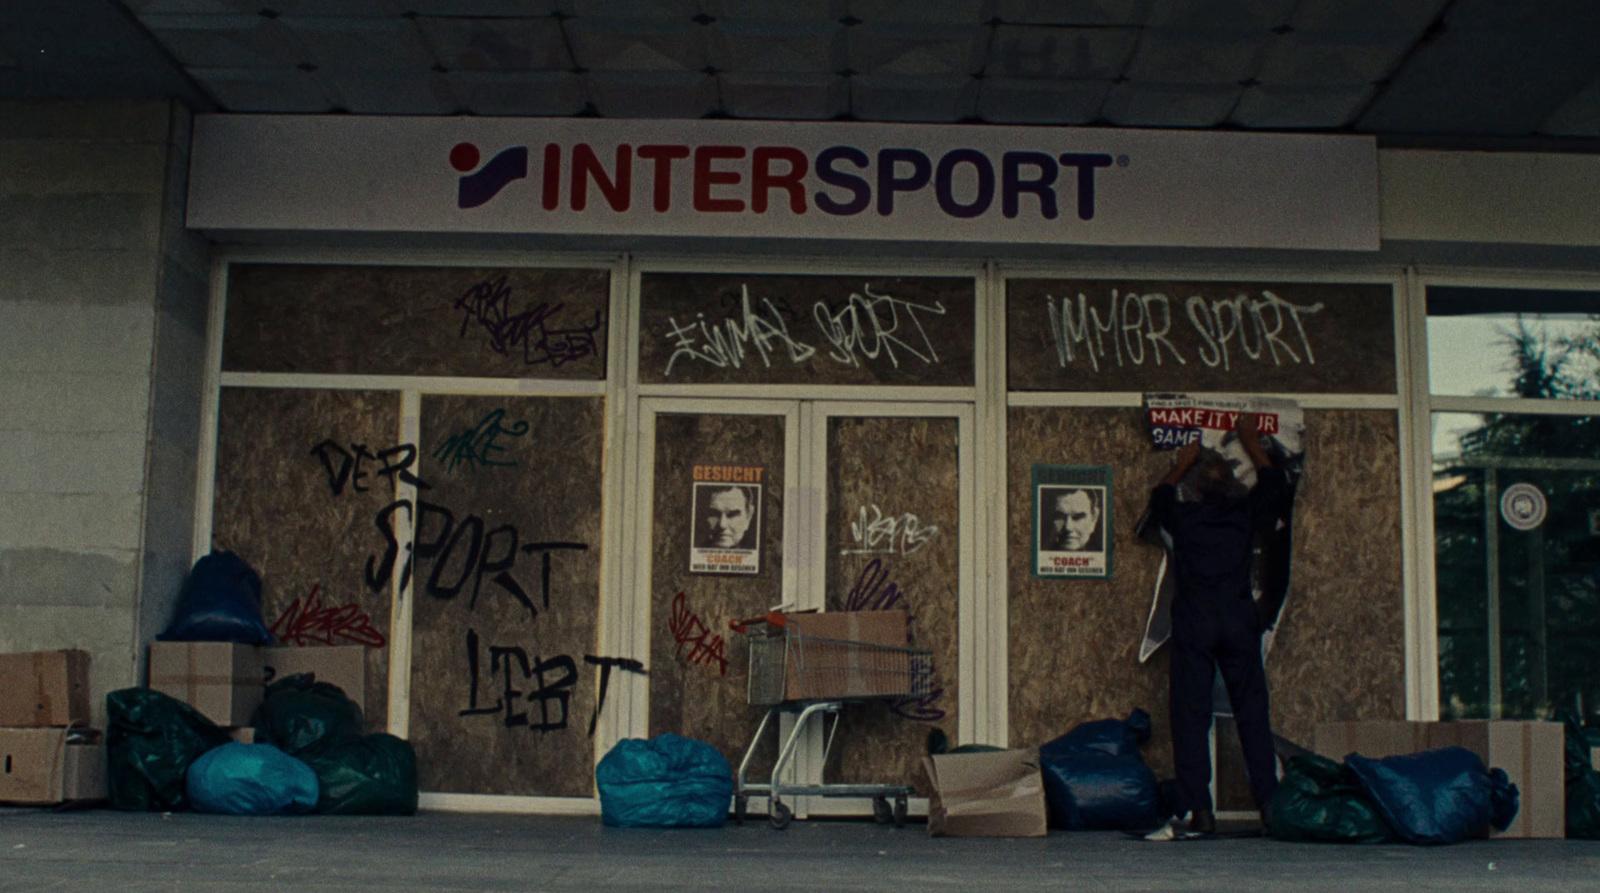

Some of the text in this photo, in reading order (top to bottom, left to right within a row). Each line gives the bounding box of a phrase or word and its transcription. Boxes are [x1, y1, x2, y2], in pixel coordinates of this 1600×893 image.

[542, 142, 1112, 220] INTERSPORT
[1185, 290, 1324, 371] SPORT
[1151, 409, 1277, 432] MAKE IT YUR
[310, 438, 431, 496] DER
[693, 464, 765, 482] GESUCHT
[364, 499, 588, 618] SPORT
[459, 627, 650, 737] LEBT
